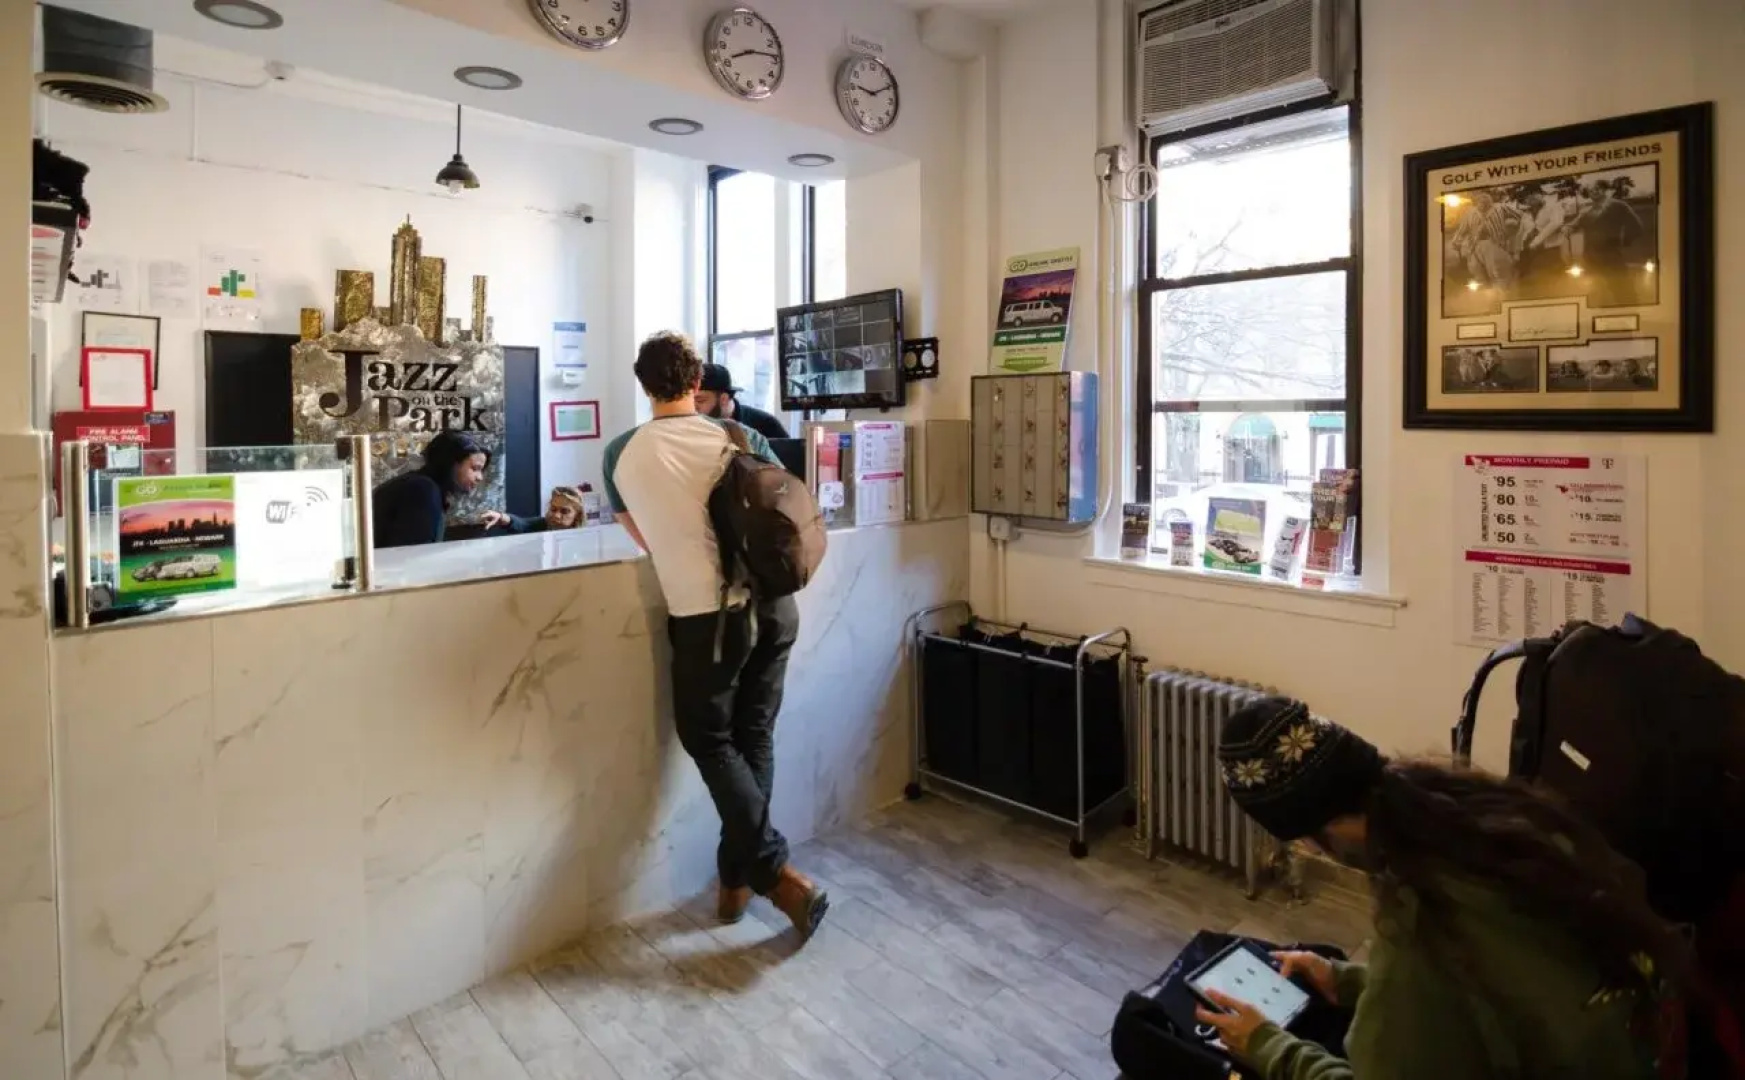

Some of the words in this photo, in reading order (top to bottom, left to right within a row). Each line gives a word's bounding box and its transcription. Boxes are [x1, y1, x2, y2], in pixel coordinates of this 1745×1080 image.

[578, 26, 588, 36] 6
[595, 26, 605, 36] 5
[1442, 170, 1483, 186] GOLF
[1487, 163, 1528, 179] WITH
[1533, 156, 1578, 172] YOUR
[1583, 142, 1662, 164] FRIENDS
[319, 349, 458, 418] Jazz
[412, 397, 430, 406] on
[434, 394, 458, 406] the
[373, 396, 487, 432] Park
